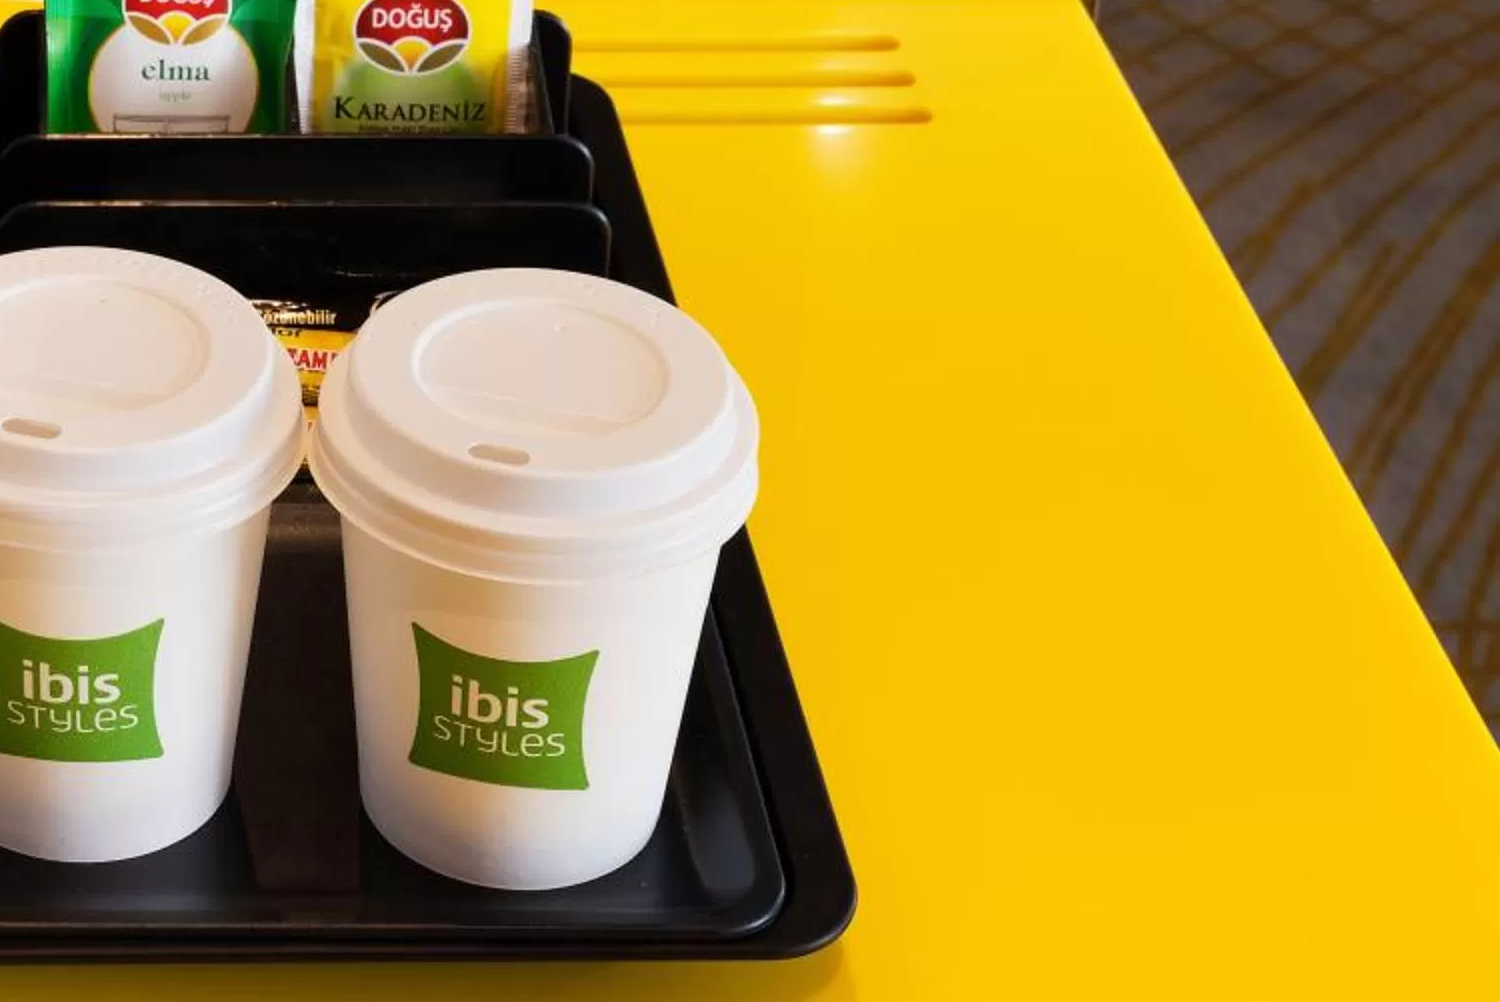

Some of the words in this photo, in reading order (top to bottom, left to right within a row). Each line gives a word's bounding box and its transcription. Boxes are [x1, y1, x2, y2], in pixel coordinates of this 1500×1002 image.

[371, 2, 453, 33] DOĞUŞ
[141, 58, 211, 82] elma
[334, 95, 488, 123] KARADENİZ
[22, 659, 121, 704] ibis
[450, 674, 549, 729] ibis
